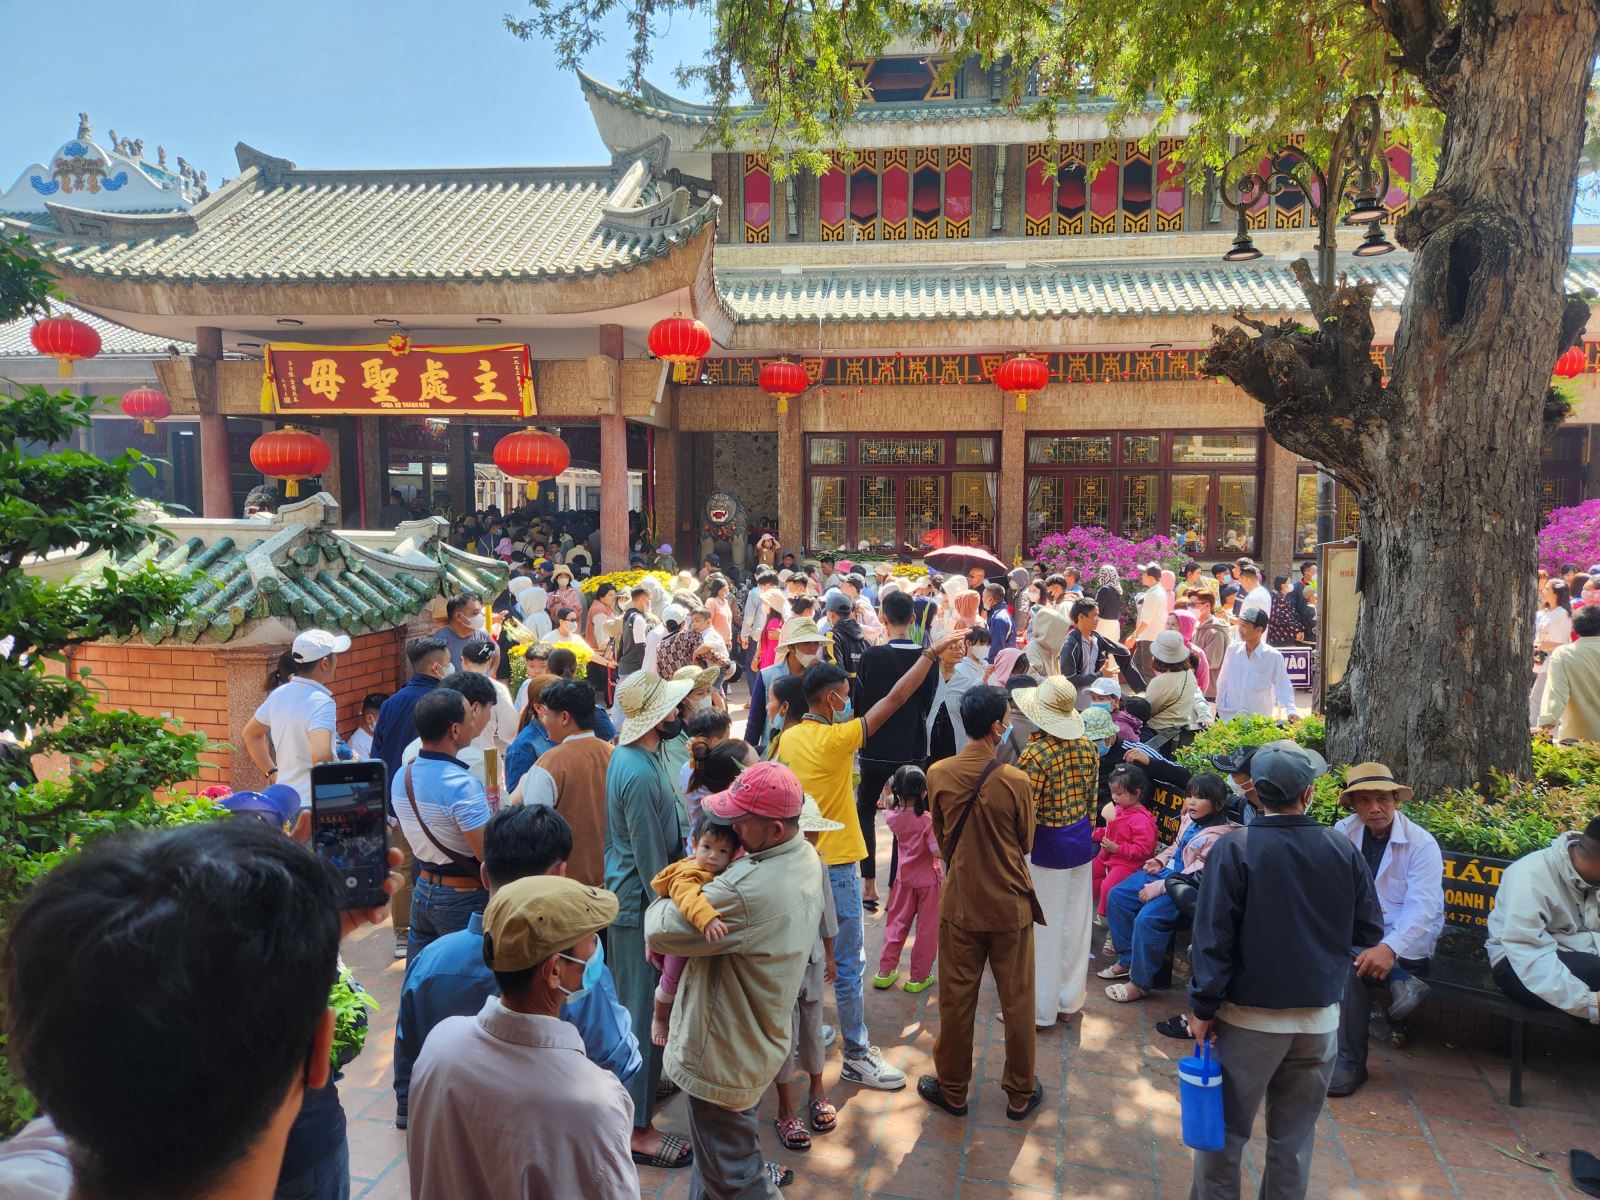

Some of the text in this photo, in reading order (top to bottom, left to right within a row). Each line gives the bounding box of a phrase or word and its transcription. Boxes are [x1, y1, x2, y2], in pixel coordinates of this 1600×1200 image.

[1284, 654, 1306, 670] VÀO
[1153, 788, 1182, 810] M P
[1442, 859, 1504, 886] HÁT
[1445, 889, 1484, 910] OANH
[1444, 911, 1455, 920] 14
[1459, 914, 1471, 923] 77
